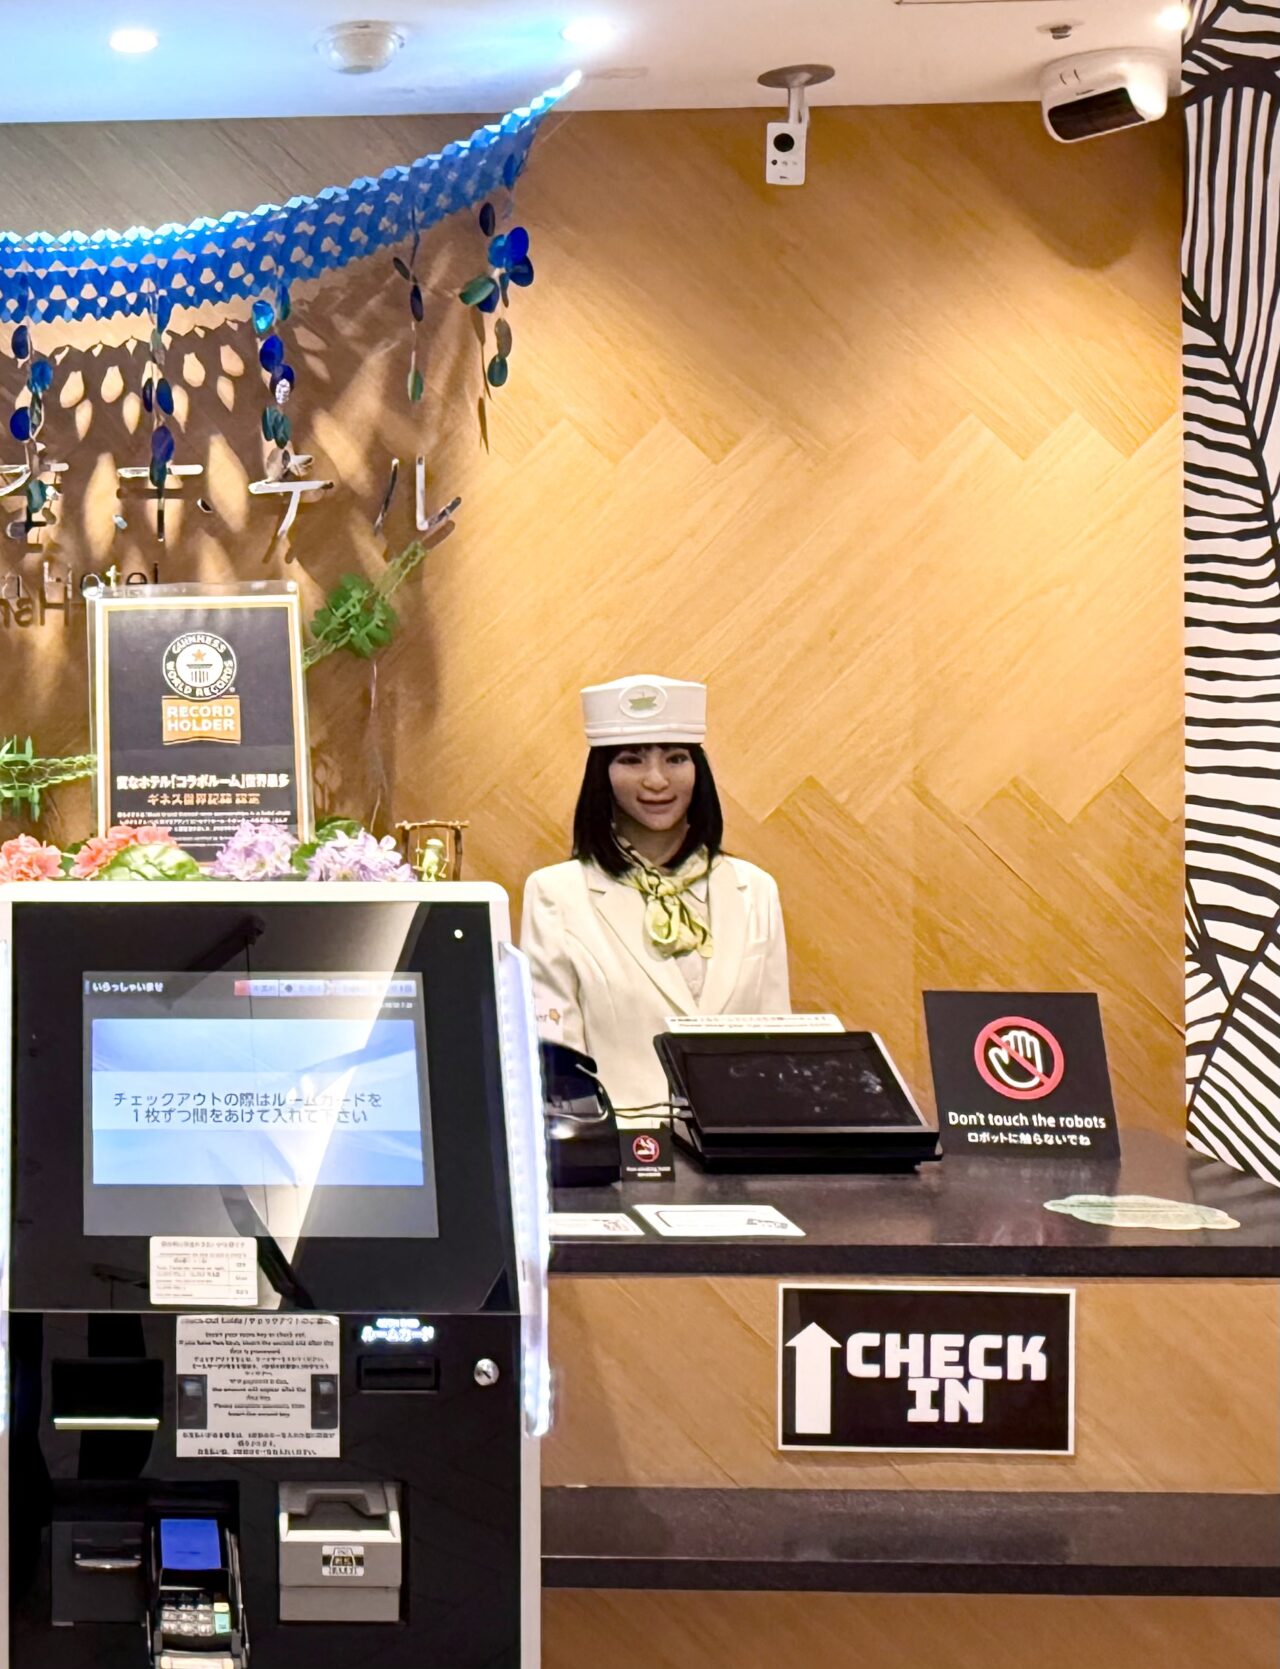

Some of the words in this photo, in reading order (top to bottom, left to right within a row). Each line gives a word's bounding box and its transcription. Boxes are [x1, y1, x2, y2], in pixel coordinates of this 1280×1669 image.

[166, 705, 235, 717] RECORD
[167, 718, 235, 731] HOLDER
[948, 1111, 985, 1126] Don't
[988, 1112, 1029, 1127] touch
[1032, 1113, 1056, 1127] the
[1059, 1115, 1107, 1129] robots
[846, 1332, 1047, 1381] CHECK
[907, 1378, 984, 1423] IN
